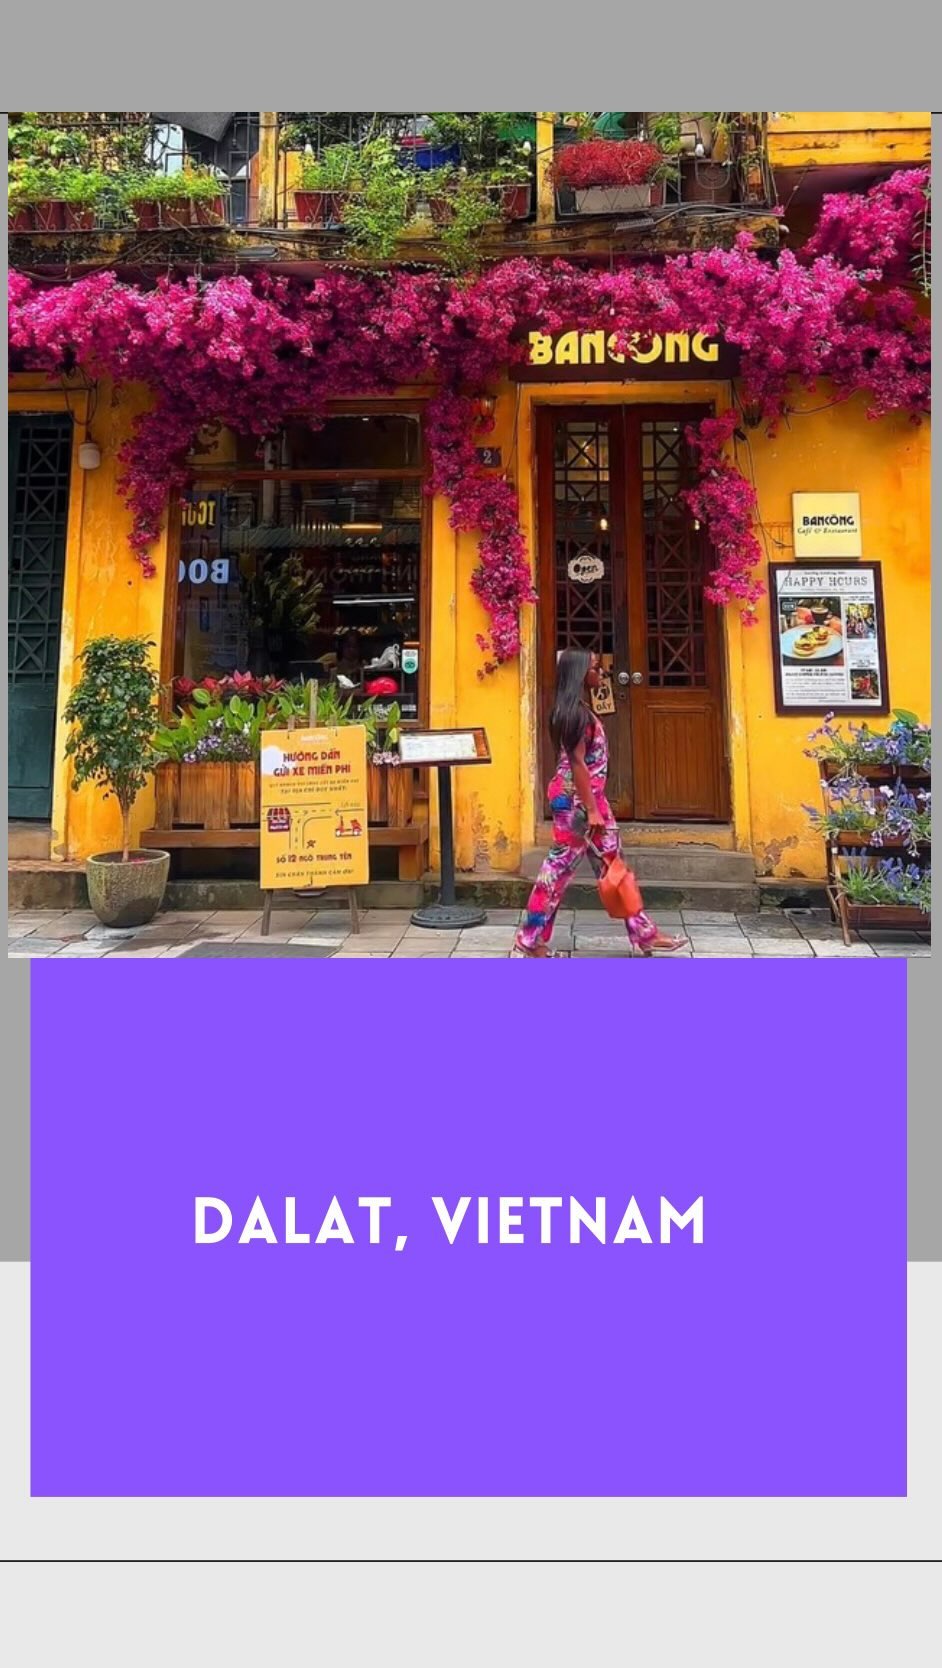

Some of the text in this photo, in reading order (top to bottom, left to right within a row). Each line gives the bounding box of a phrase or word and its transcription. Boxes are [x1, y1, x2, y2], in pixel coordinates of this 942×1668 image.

[573, 563, 598, 576] Open
[784, 576, 868, 587] HAPPY HOURS
[293, 767, 305, 777] XE
